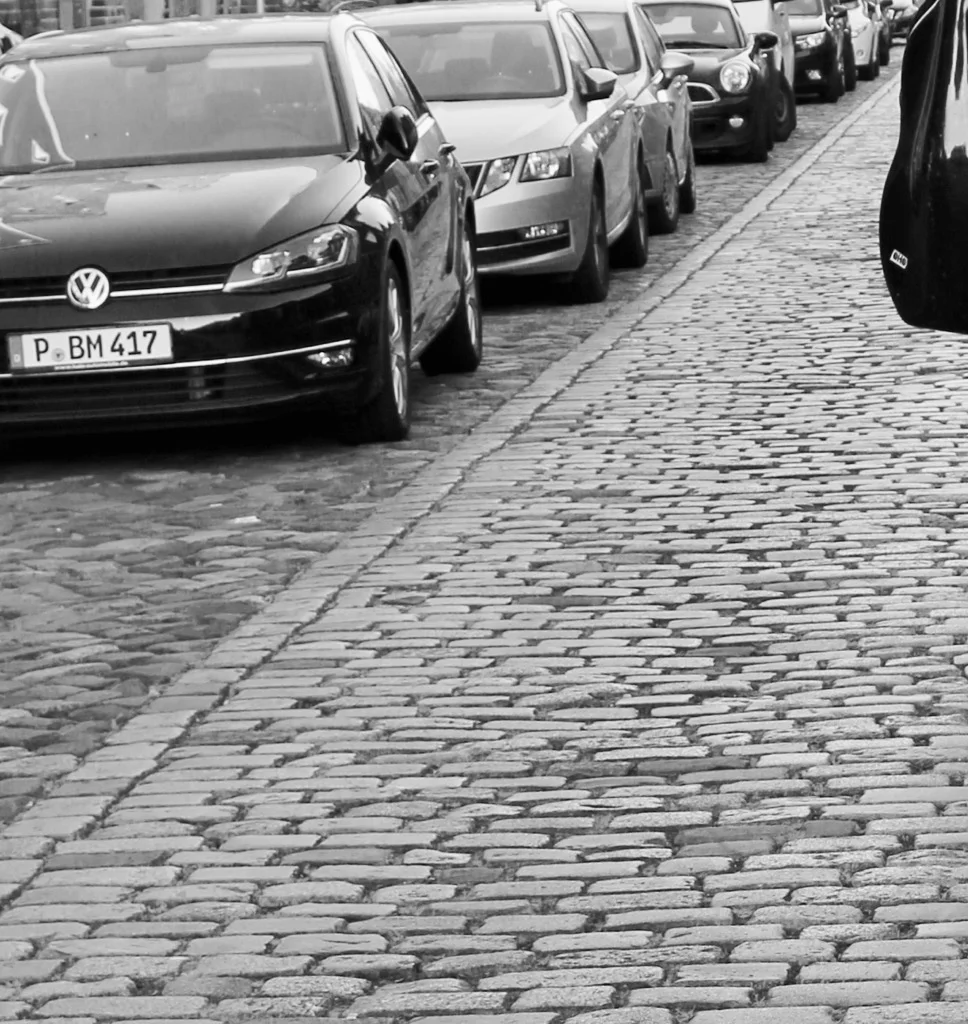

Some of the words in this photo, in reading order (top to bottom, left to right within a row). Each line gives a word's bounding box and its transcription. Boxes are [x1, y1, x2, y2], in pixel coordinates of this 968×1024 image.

[34, 337, 49, 362] P
[69, 334, 103, 360] BM
[110, 330, 157, 357] 417
